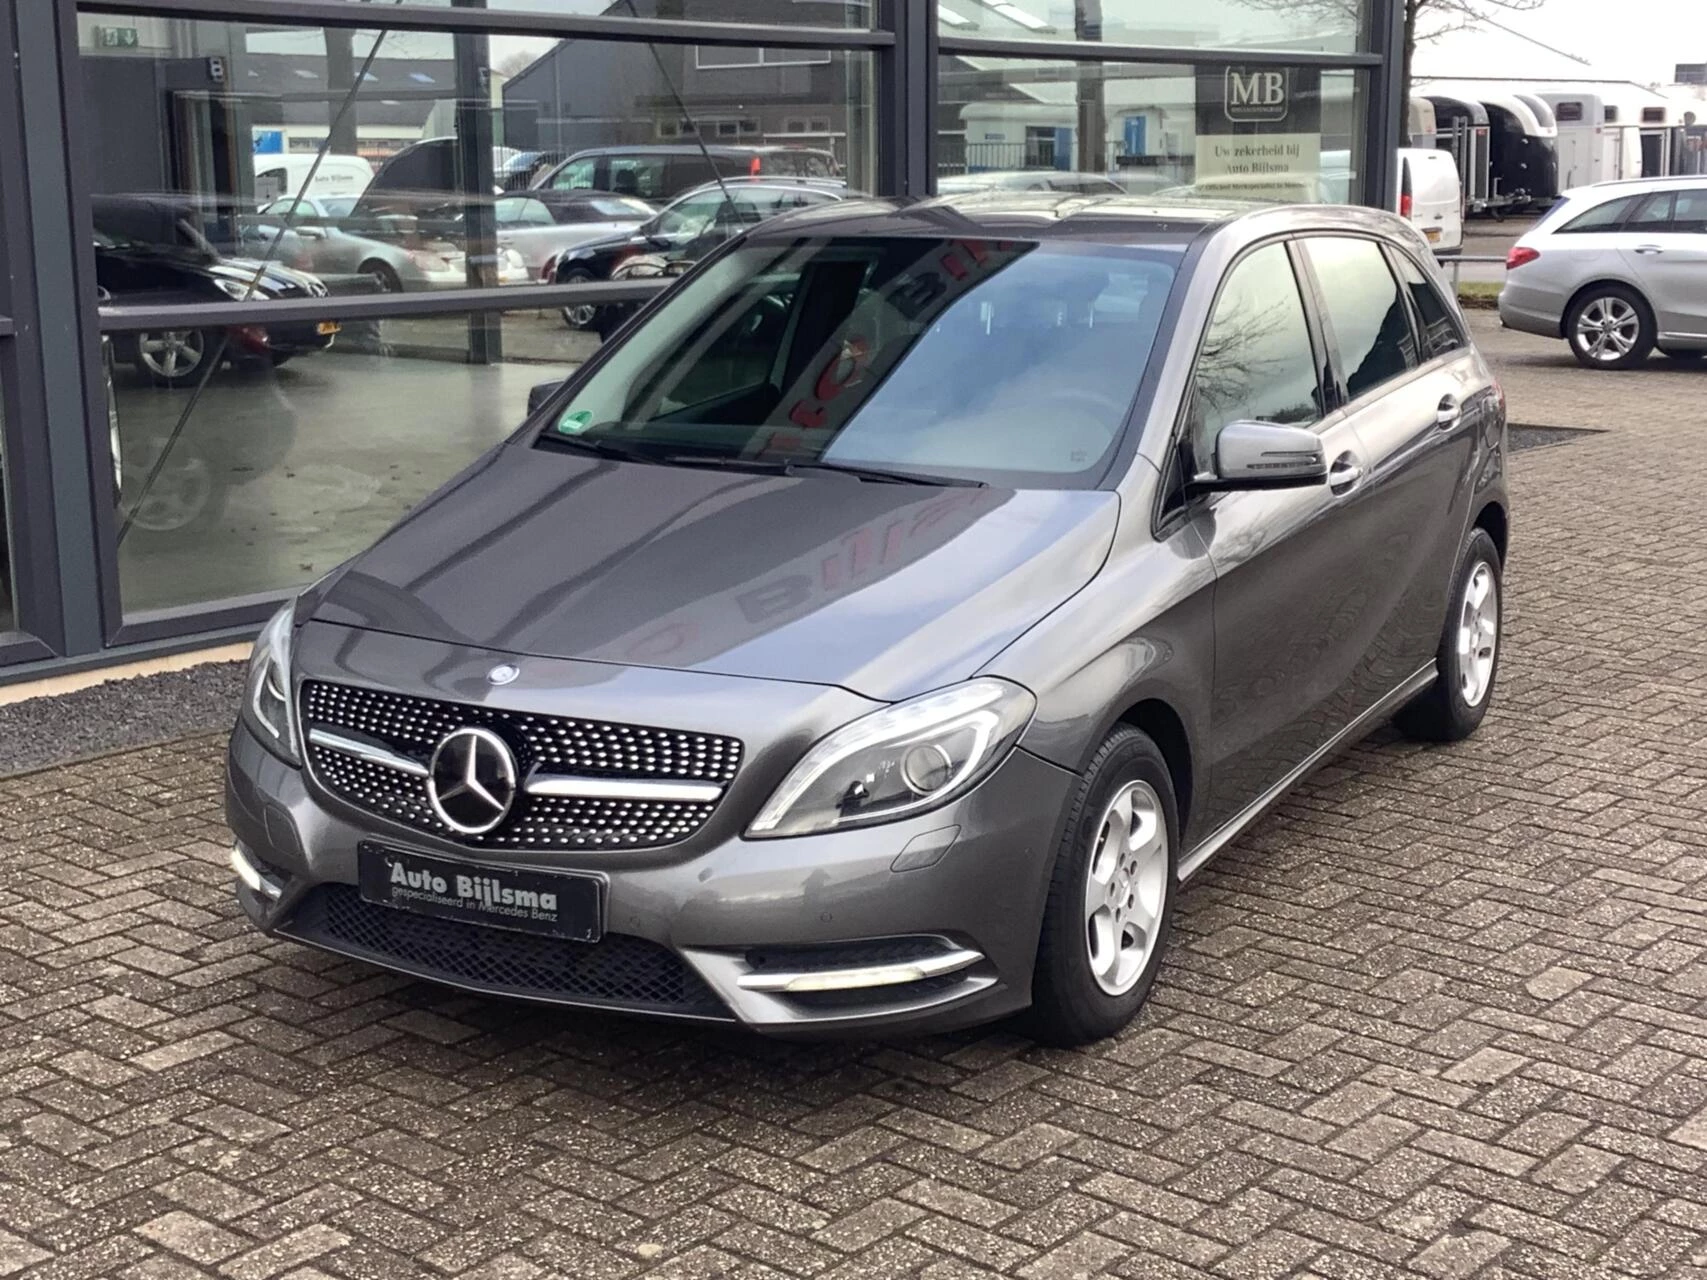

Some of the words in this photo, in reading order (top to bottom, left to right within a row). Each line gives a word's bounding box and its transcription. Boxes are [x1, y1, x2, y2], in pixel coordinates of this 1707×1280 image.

[1230, 72, 1284, 105] MB
[1234, 144, 1284, 157] zekerheid
[1286, 144, 1300, 158] bij
[1226, 163, 1249, 174] Auto
[1252, 162, 1289, 174] Bijlsma
[390, 862, 447, 893] Auto
[456, 875, 557, 911] Bijlsma
[392, 886, 464, 908] gespecialiseerd
[466, 901, 476, 909] in
[478, 901, 528, 918] Mercedes
[531, 909, 558, 922] Benz
